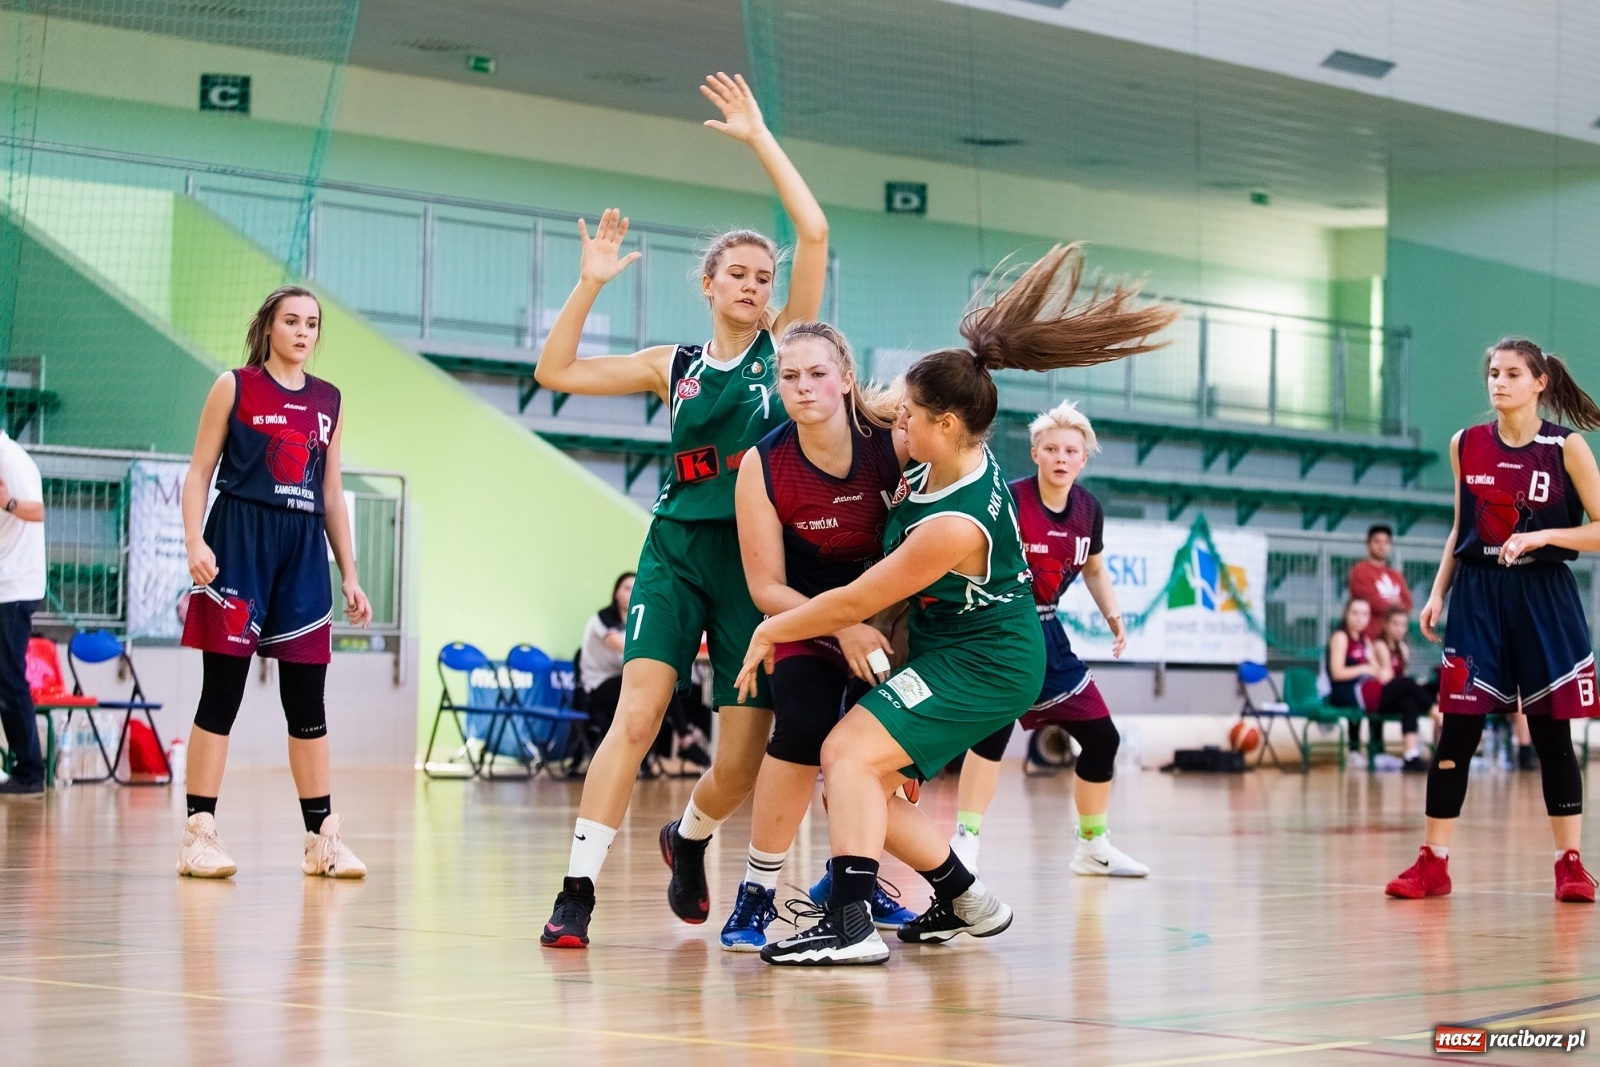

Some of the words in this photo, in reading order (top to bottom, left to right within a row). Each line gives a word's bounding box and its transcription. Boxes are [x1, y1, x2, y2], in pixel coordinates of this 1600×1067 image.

[209, 86, 239, 108] C
[749, 384, 770, 420] 7
[317, 411, 332, 446] 12
[678, 451, 716, 481] K
[1528, 470, 1550, 503] 13
[809, 517, 839, 530] DWÓJKA
[1074, 536, 1091, 566] 10
[631, 603, 645, 640] 7
[1578, 679, 1594, 707] 13
